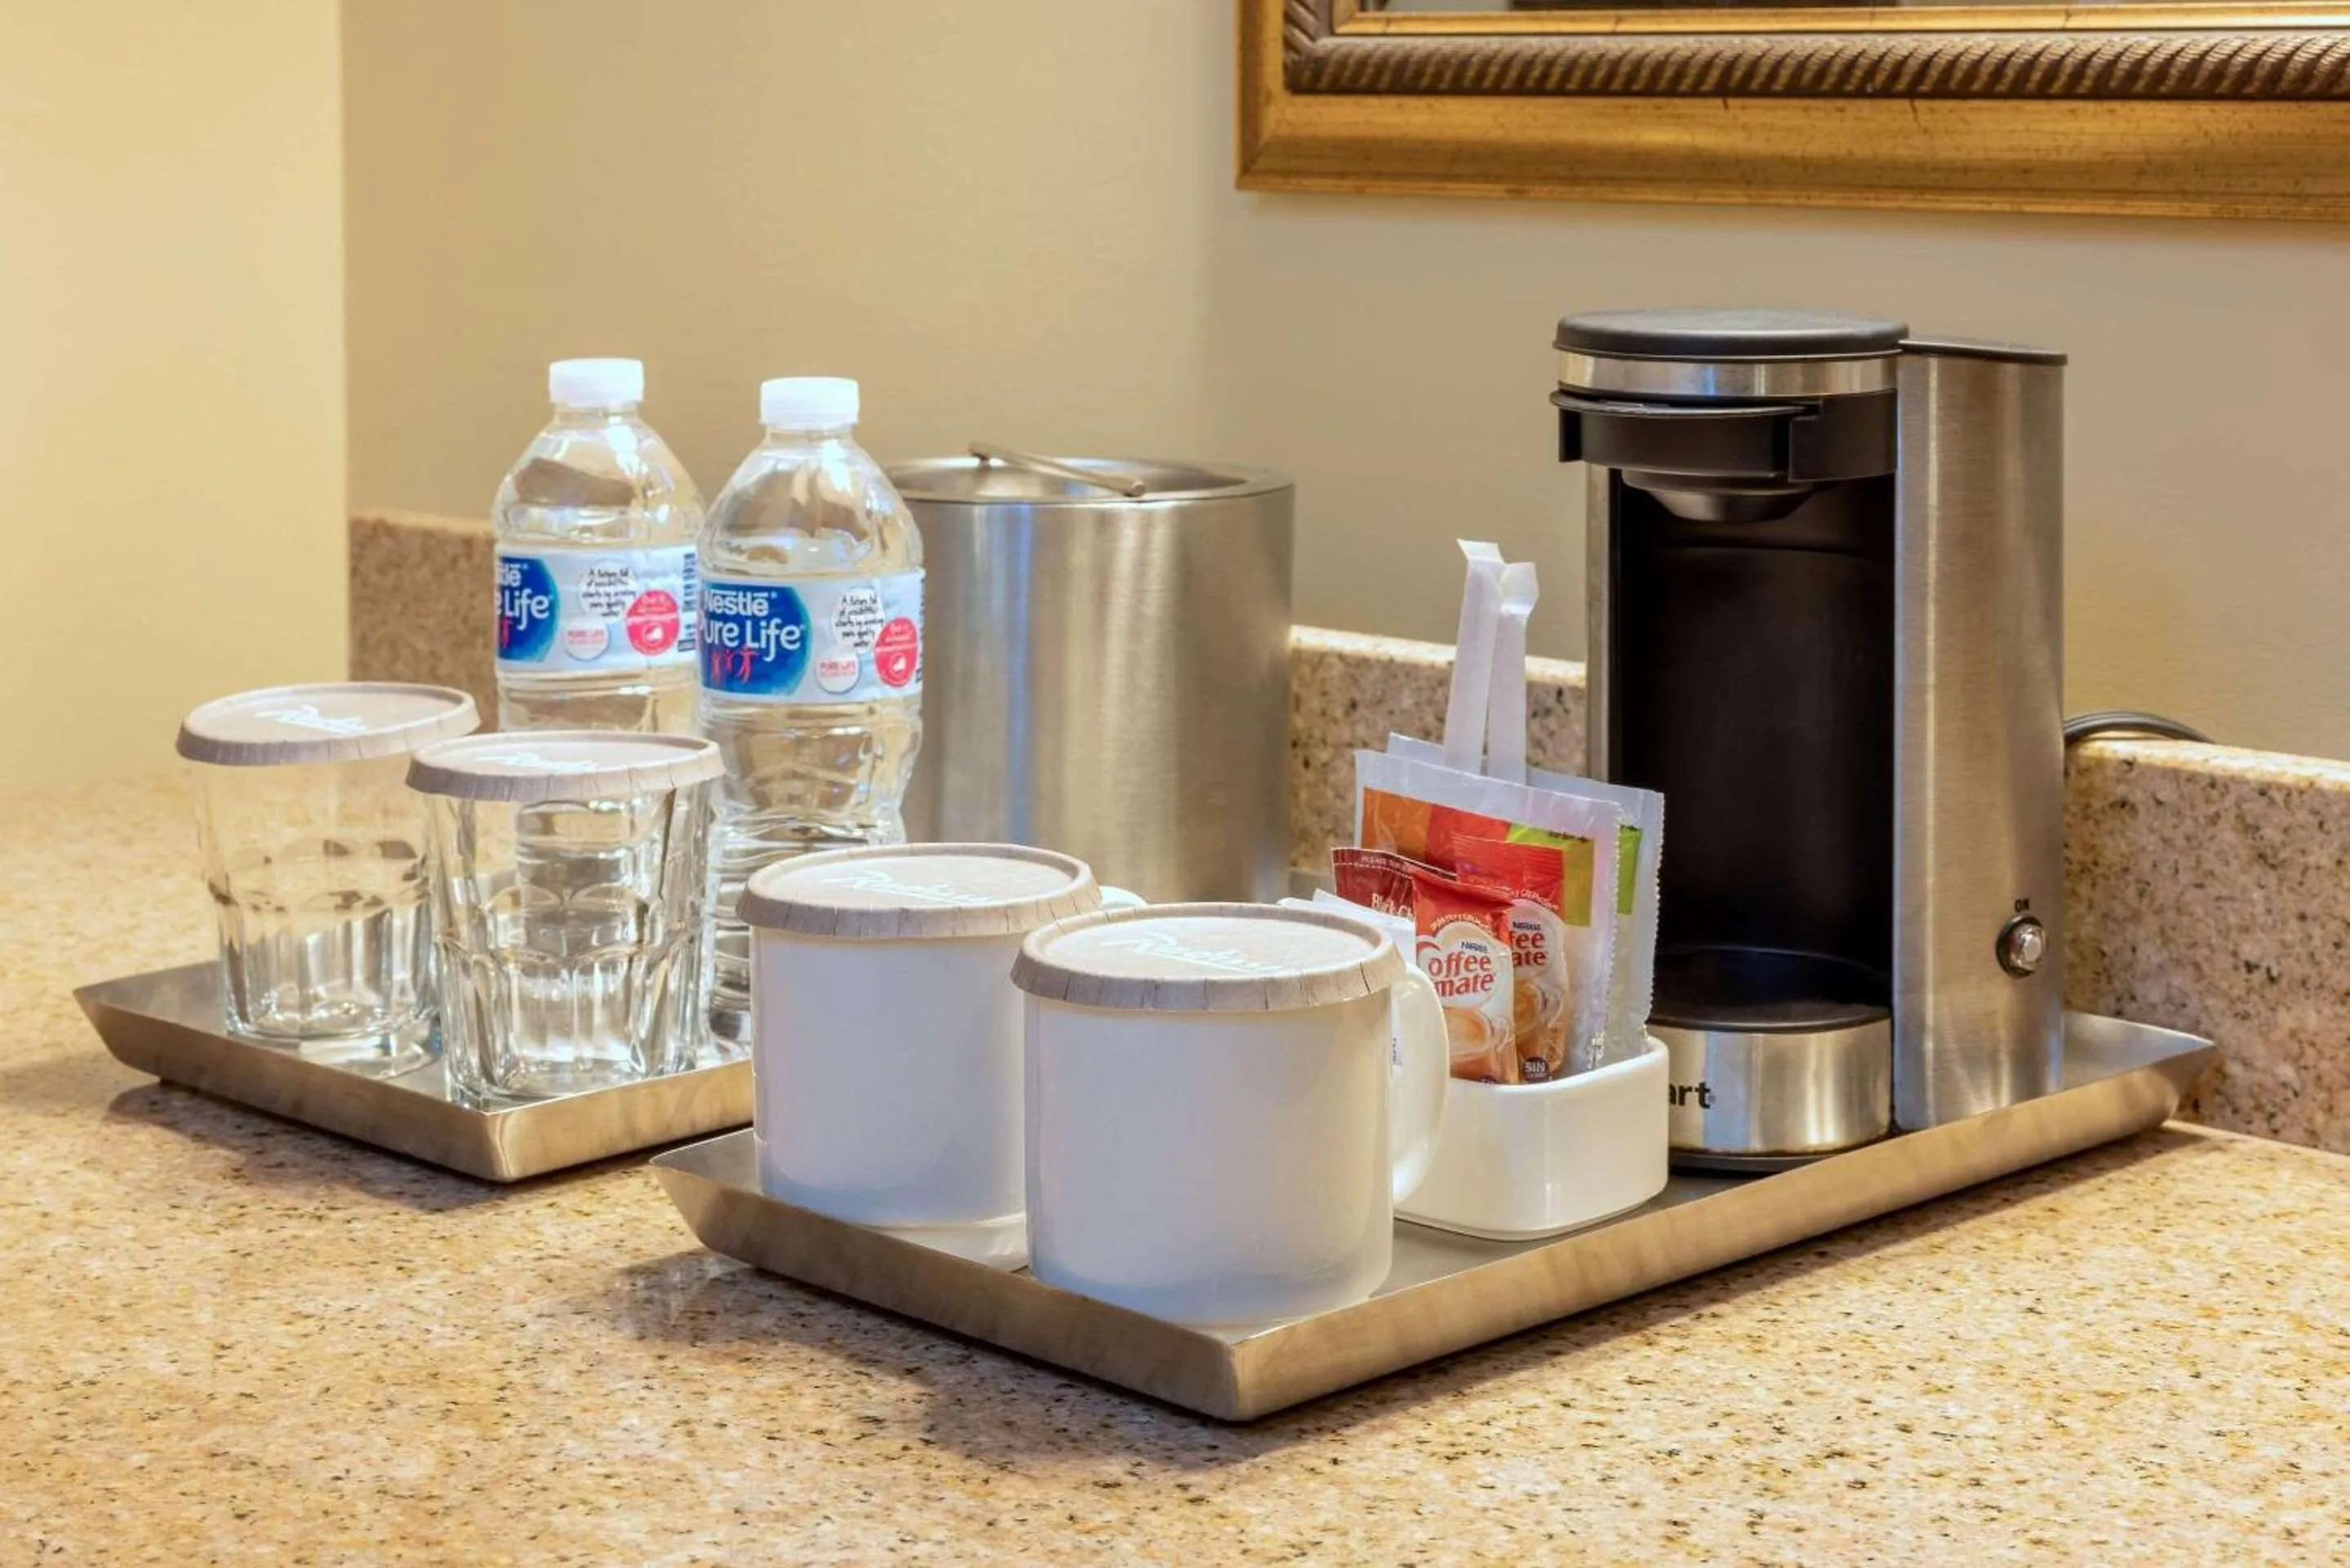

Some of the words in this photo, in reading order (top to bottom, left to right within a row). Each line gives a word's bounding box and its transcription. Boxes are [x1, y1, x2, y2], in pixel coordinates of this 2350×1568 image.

[504, 588, 550, 631] Life
[745, 618, 801, 662] Life
[1512, 951, 1546, 969] ate
[1434, 973, 1495, 997] mate
[1525, 1061, 1546, 1072] SIN
